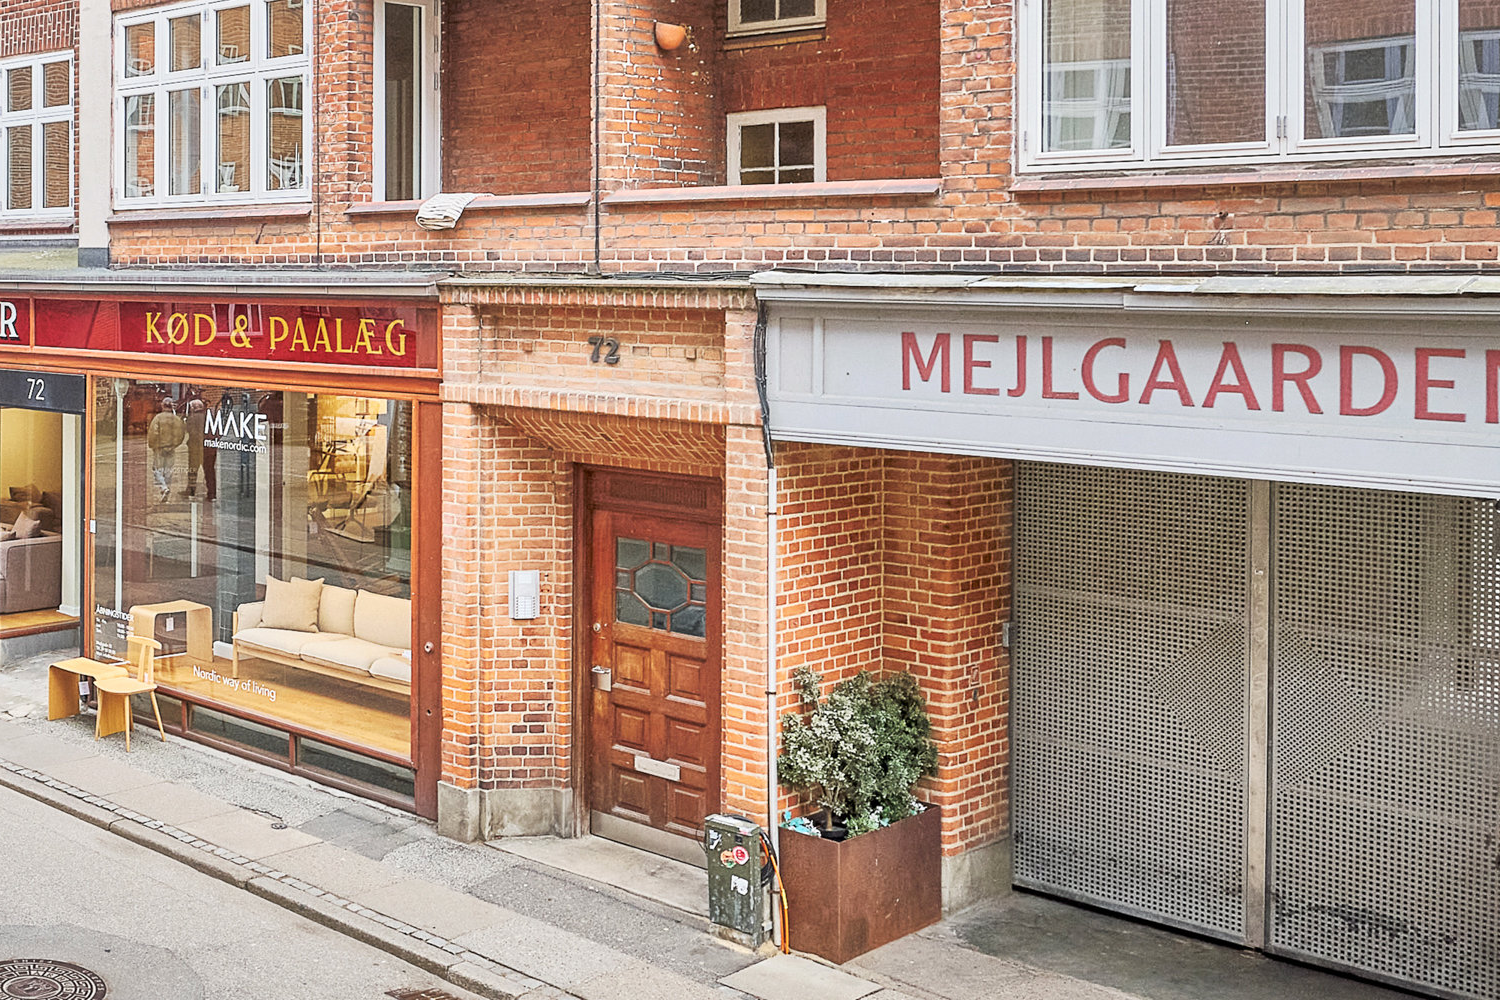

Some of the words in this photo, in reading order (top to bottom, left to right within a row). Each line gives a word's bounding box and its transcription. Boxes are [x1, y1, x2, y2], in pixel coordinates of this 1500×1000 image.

[145, 312, 217, 346] KØD
[230, 314, 253, 348] &
[269, 316, 406, 356] PAALÆG
[588, 336, 620, 364] 72
[26, 378, 45, 400] 72
[204, 409, 267, 440] MAKE
[203, 438, 267, 454] makenordic.com
[193, 665, 221, 683] Nordic
[222, 676, 240, 691] way
[241, 680, 251, 691] of
[252, 681, 276, 701] living
